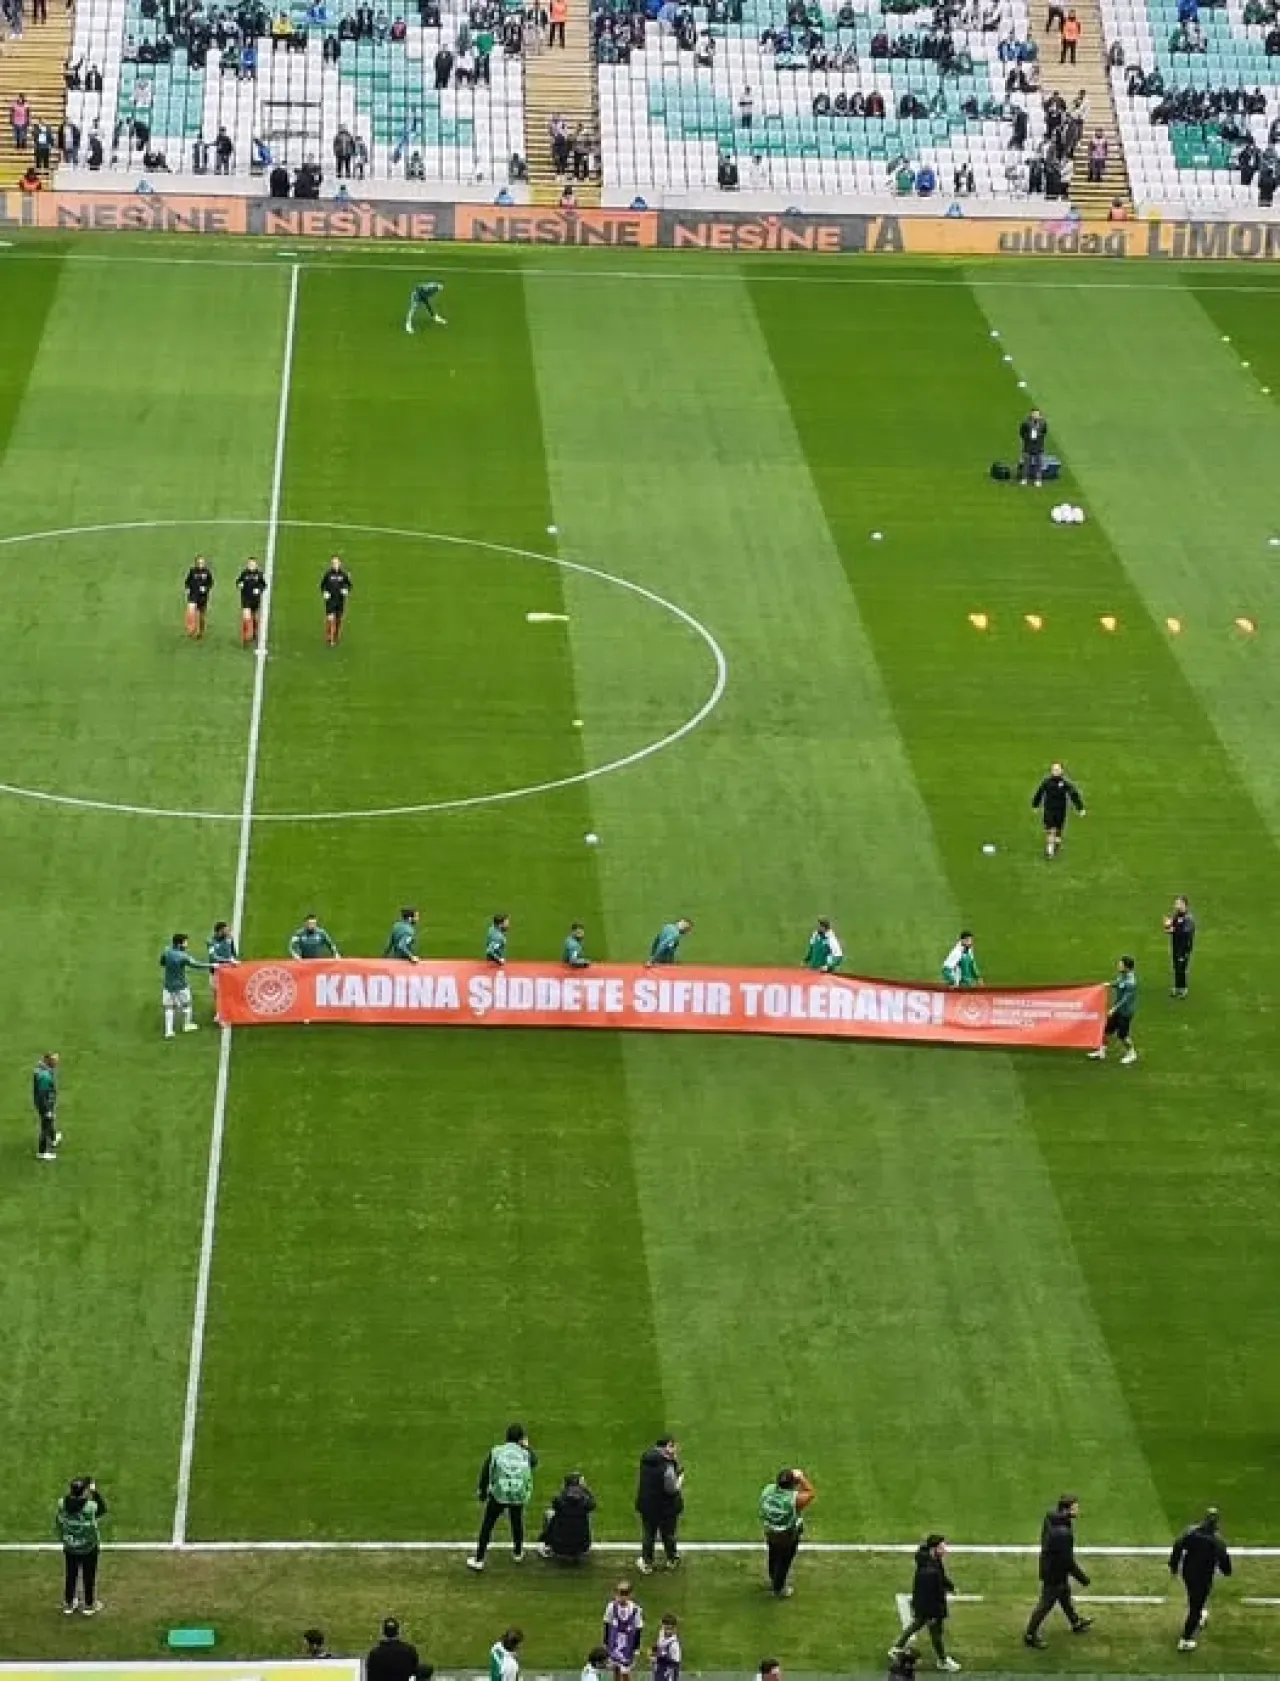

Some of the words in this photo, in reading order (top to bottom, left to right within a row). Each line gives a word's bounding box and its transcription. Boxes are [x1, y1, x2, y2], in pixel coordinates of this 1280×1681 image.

[315, 973, 461, 1010] KADINA
[468, 971, 624, 1015] ŞİDDETE
[632, 979, 731, 1015] SIFIR
[740, 982, 945, 1025] TOLERANS!
